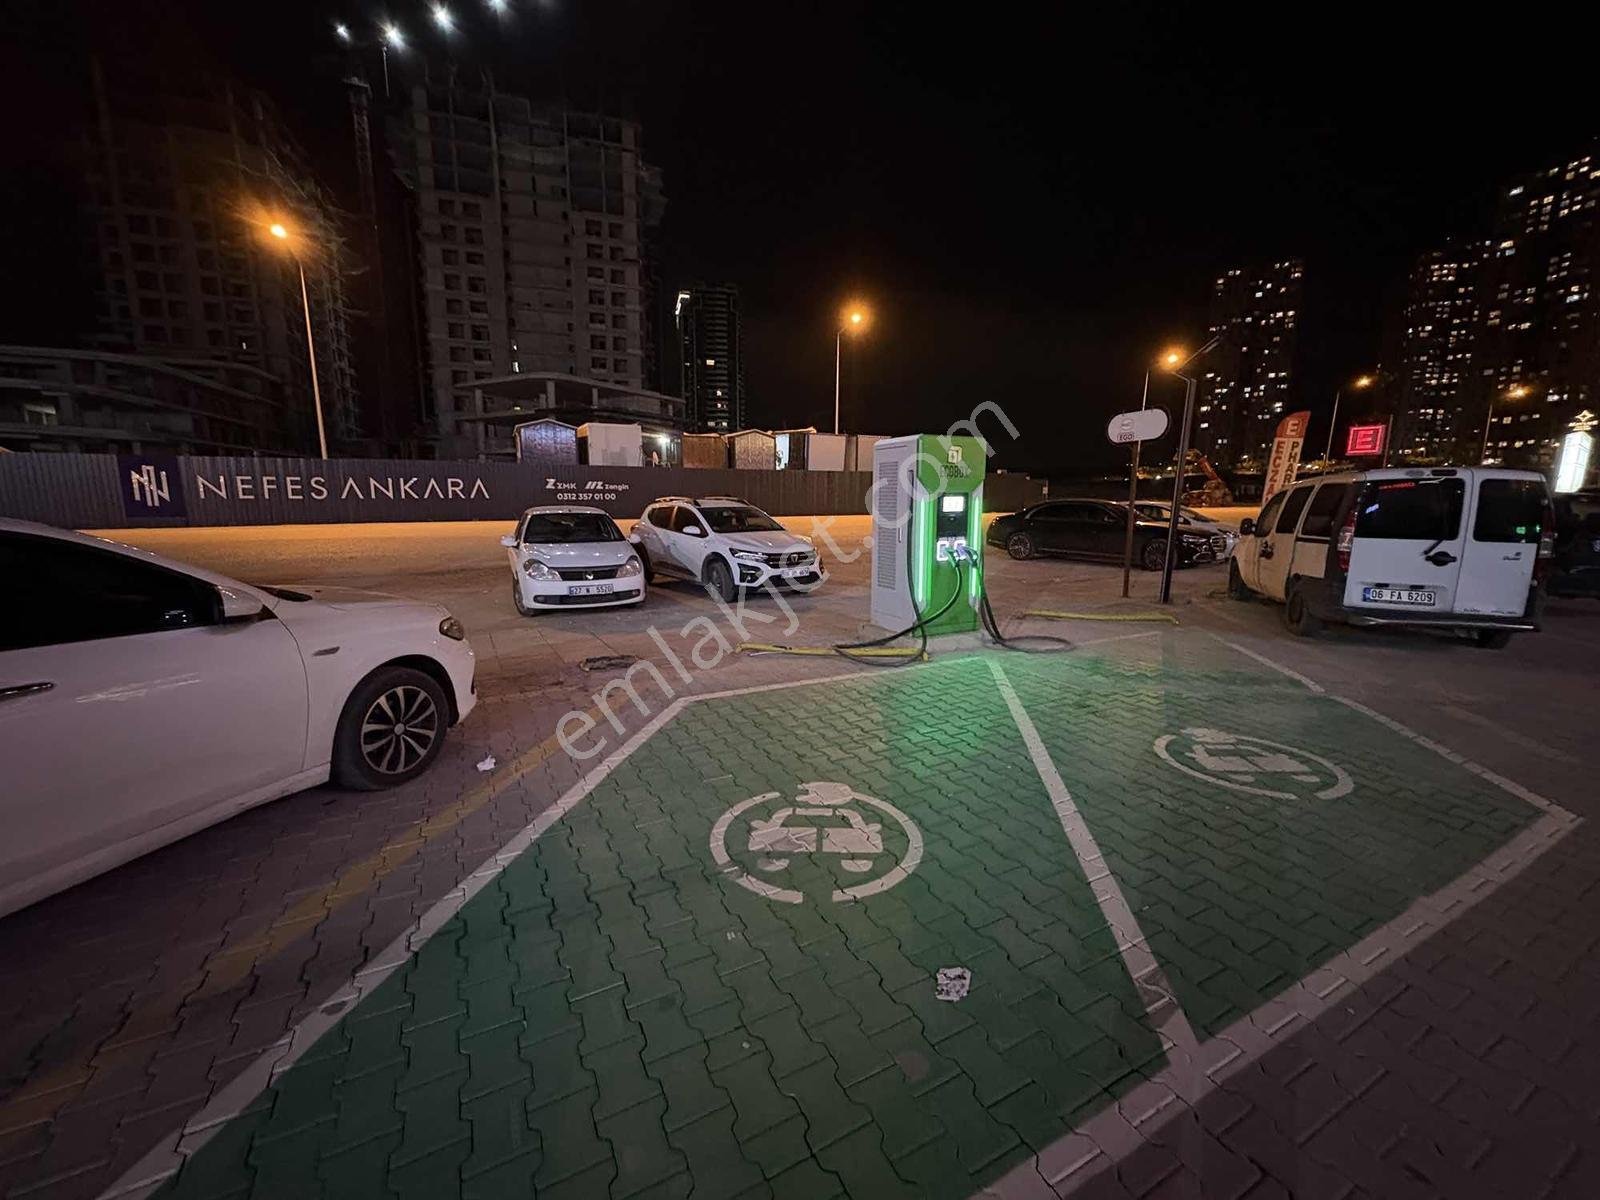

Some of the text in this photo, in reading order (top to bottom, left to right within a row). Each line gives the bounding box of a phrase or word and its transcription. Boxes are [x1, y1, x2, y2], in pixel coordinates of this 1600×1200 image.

[1356, 430, 1374, 449] E
[196, 475, 490, 500] NEFES ANKARA
[1371, 590, 1433, 602] 06 FA 6209
